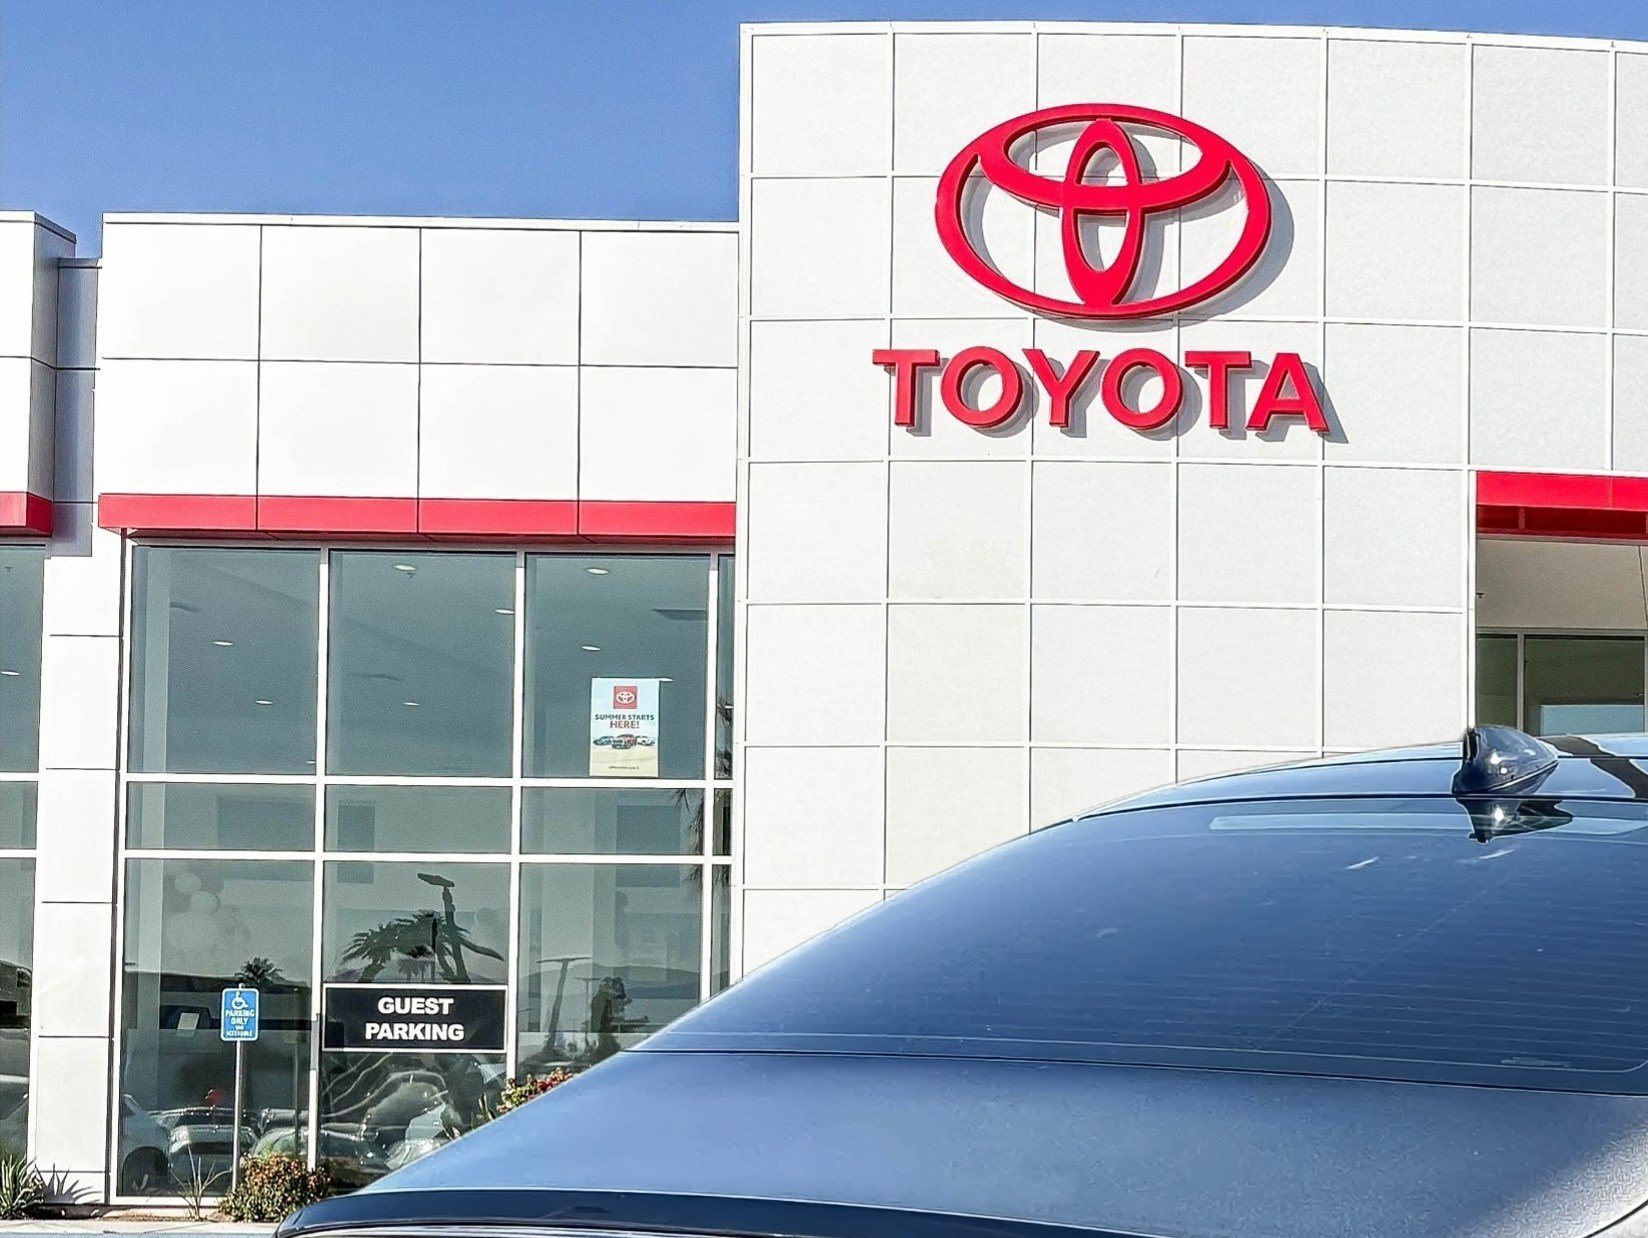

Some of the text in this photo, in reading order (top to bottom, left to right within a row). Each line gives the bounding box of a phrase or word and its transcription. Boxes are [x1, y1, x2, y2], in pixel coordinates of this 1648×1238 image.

[872, 346, 1330, 432] TOYOTA
[609, 720, 640, 729] HERE!
[378, 996, 454, 1015] GUEST
[225, 1009, 255, 1018] PARKING
[231, 1017, 249, 1025] ONLY
[365, 1022, 465, 1042] PARKING
